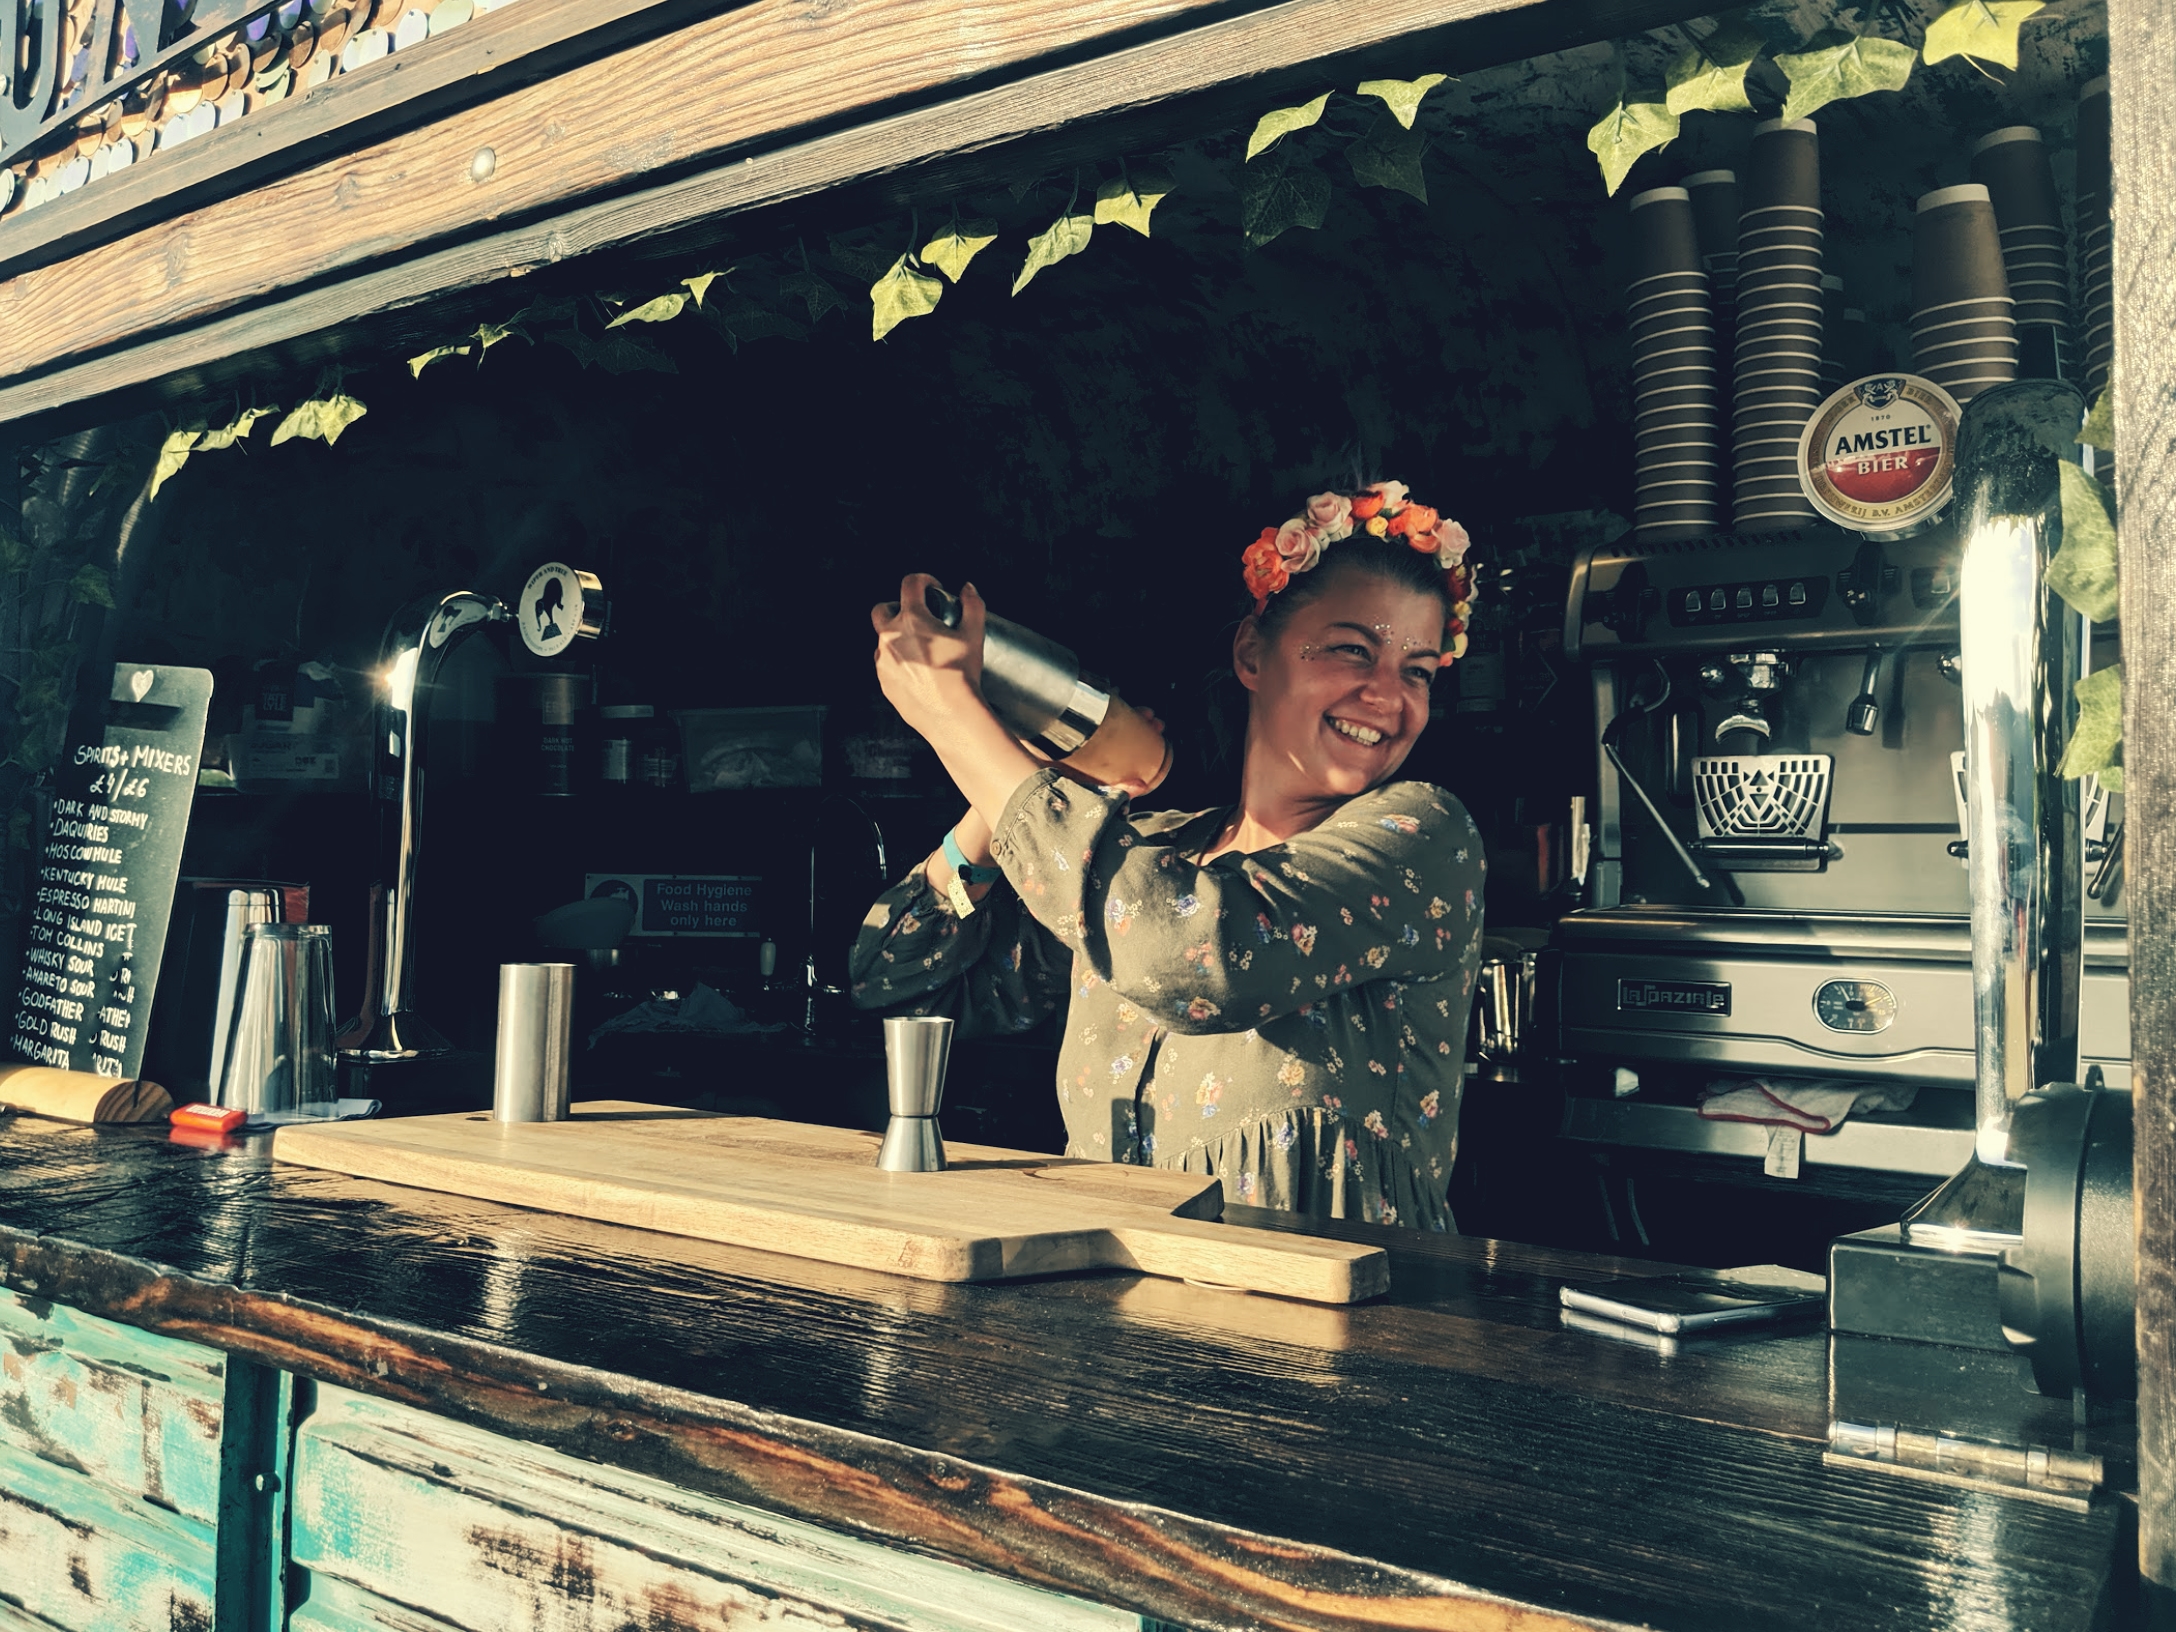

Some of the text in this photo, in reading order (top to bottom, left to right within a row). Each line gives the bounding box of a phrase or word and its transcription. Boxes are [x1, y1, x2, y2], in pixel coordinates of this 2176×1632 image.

[1835, 425, 1931, 455] AMSTEL
[1858, 456, 1908, 475] BIER
[131, 745, 192, 775] MIXERS
[57, 798, 149, 830] DARK AND STORMY
[53, 818, 109, 843] DAQUIRIES
[43, 866, 95, 890] KENTUCKY
[656, 883, 752, 899] Food Hygiene
[39, 887, 90, 910] ESPRESSO
[661, 900, 748, 912] Wash hands
[36, 906, 63, 925] LONG
[67, 914, 103, 936] ISLAND
[670, 915, 737, 929] only here
[32, 925, 105, 958] TOM COLLINS
[30, 947, 65, 970] WHISKY
[68, 955, 94, 977] SOUR
[70, 979, 95, 998] SOUR
[22, 987, 84, 1021] GODFATHER
[18, 1010, 48, 1035] GOLD
[50, 1021, 77, 1045] RUSH
[100, 1029, 127, 1053] RUSH
[12, 1034, 70, 1071] MARGARITA
